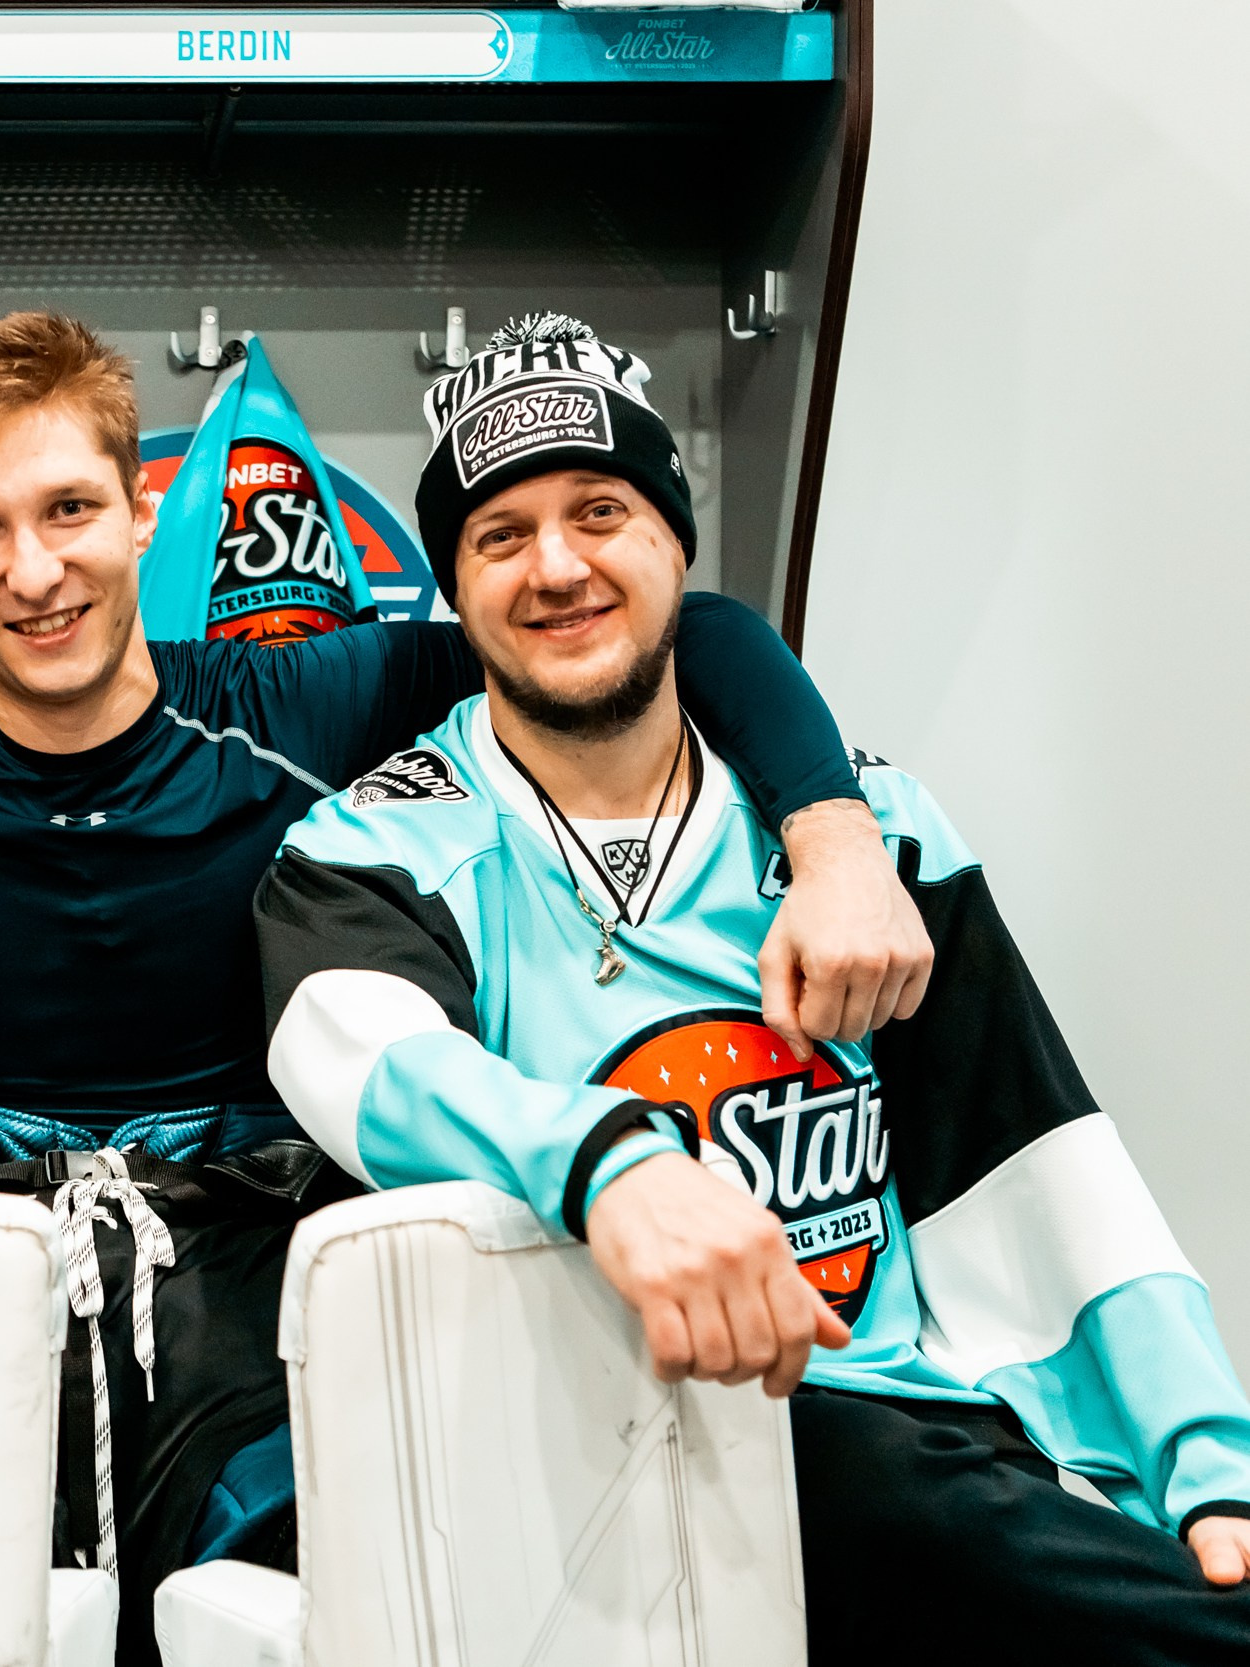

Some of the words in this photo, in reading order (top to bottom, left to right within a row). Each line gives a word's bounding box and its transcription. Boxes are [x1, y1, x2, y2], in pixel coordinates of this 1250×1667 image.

[637, 19, 686, 29] FONBET
[177, 30, 291, 61] BERDIN
[605, 31, 715, 60] All-Star
[463, 390, 599, 461] All-Star
[486, 428, 558, 463] PETERSBURG
[567, 427, 597, 439] TULA
[224, 462, 302, 488] NBET
[208, 585, 315, 619] TERSBURG
[831, 1209, 872, 1241] 2023
